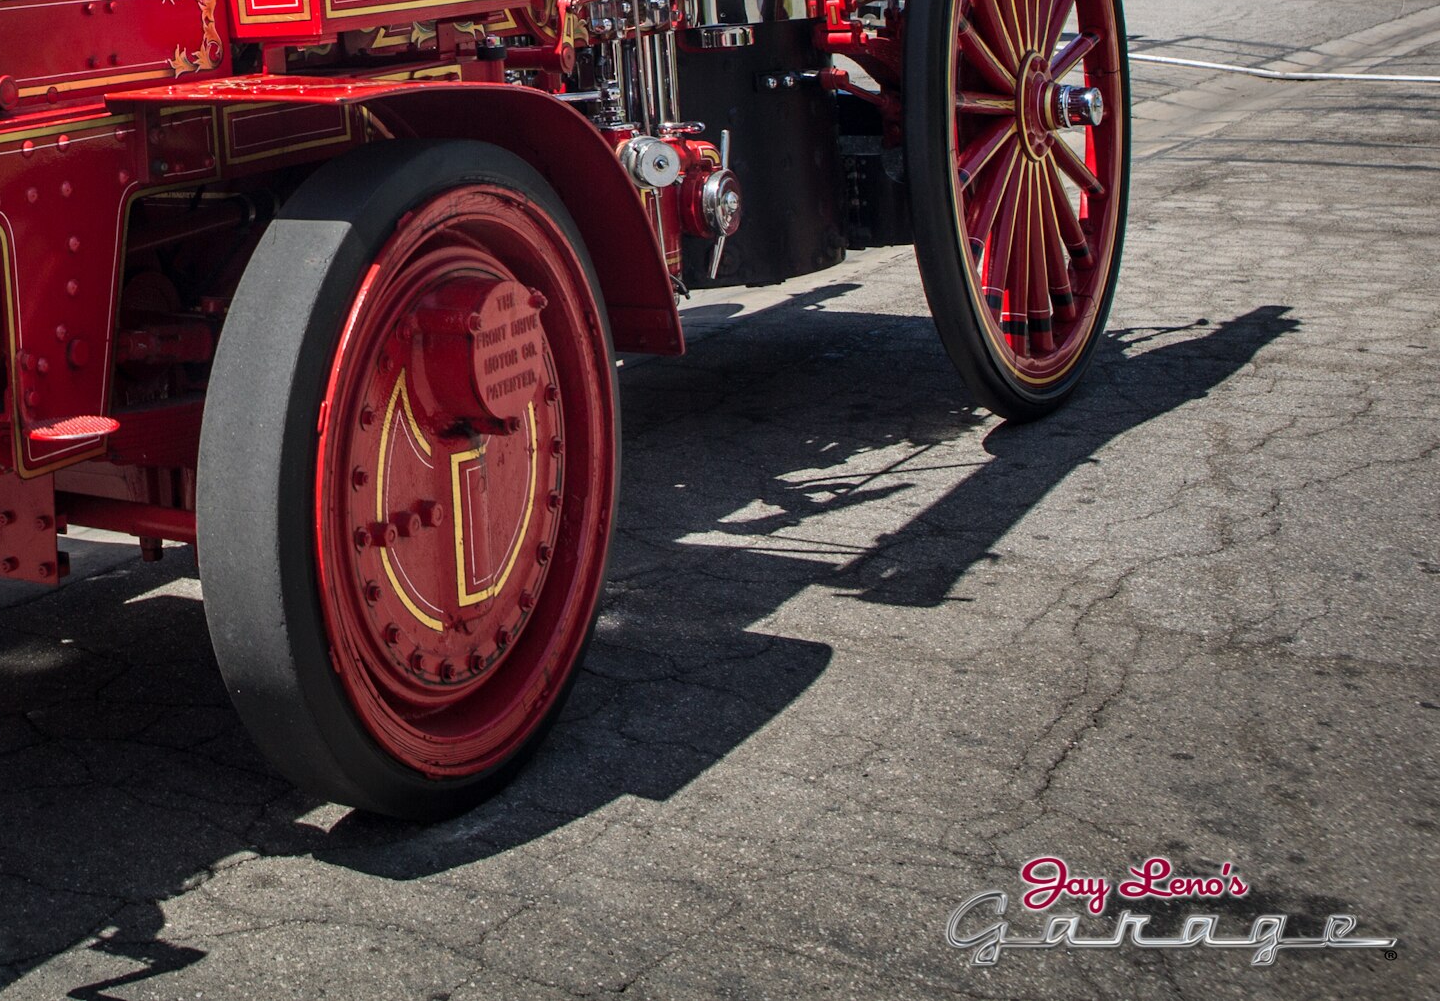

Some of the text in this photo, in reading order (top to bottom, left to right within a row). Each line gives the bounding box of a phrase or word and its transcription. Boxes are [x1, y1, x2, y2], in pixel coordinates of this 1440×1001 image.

[497, 292, 515, 312] THE
[476, 313, 538, 350] FRONT DRIVE
[484, 341, 538, 375] MOTOR CO.
